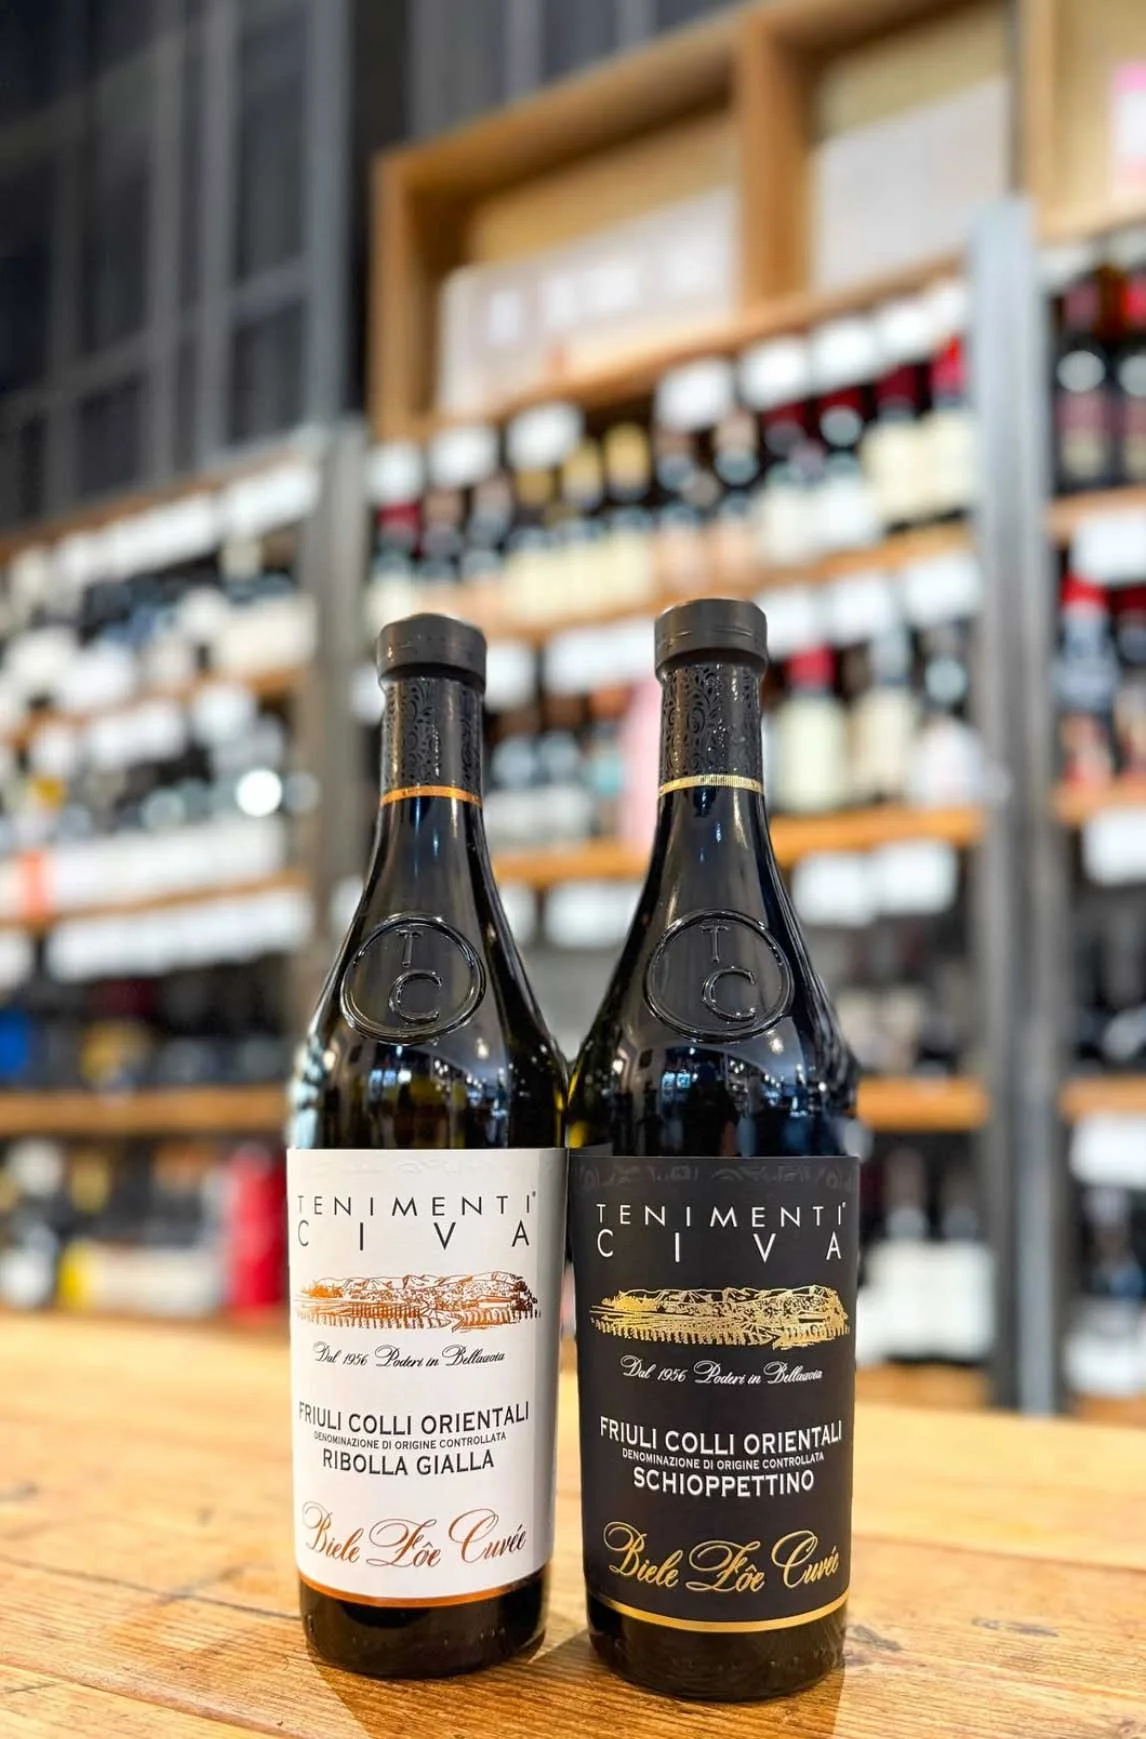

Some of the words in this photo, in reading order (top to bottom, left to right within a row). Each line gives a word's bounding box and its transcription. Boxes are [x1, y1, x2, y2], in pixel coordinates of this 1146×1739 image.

[297, 1194, 533, 1217] TENIMENTI
[596, 1203, 844, 1228] TENIMENTI
[312, 1341, 342, 1363] Dal
[343, 1353, 369, 1367] 1956
[374, 1344, 424, 1368] Poderi
[425, 1356, 440, 1367] in
[620, 1354, 656, 1379] Dal
[656, 1367, 688, 1383] 1956
[693, 1359, 746, 1385] Poderi
[746, 1373, 762, 1385] in
[299, 1401, 342, 1431] FRIULI
[348, 1413, 412, 1436] COLLI
[421, 1401, 530, 1434] ORIENTALI
[313, 1430, 380, 1450] DENOMINAZIONE
[382, 1440, 392, 1449] DI
[395, 1440, 437, 1450] ORIGINE
[439, 1431, 507, 1448] CONTROLLATA
[600, 1416, 657, 1449] FRIULI
[665, 1430, 735, 1456] COLLI
[743, 1419, 843, 1455] ORIENTALI
[323, 1448, 409, 1476] RIBOLLA
[416, 1449, 495, 1476] GIALLA
[622, 1447, 701, 1469] DENOMINAZIONE
[703, 1459, 714, 1469] DI
[716, 1460, 760, 1470] ORIGINE
[762, 1451, 825, 1469] CONTROLLATA
[633, 1466, 815, 1497] SCHIOPPETTINO
[302, 1500, 364, 1564] Biele
[448, 1508, 528, 1563] Cuvée
[603, 1521, 683, 1588] Biele
[771, 1529, 840, 1589] Cuvée
